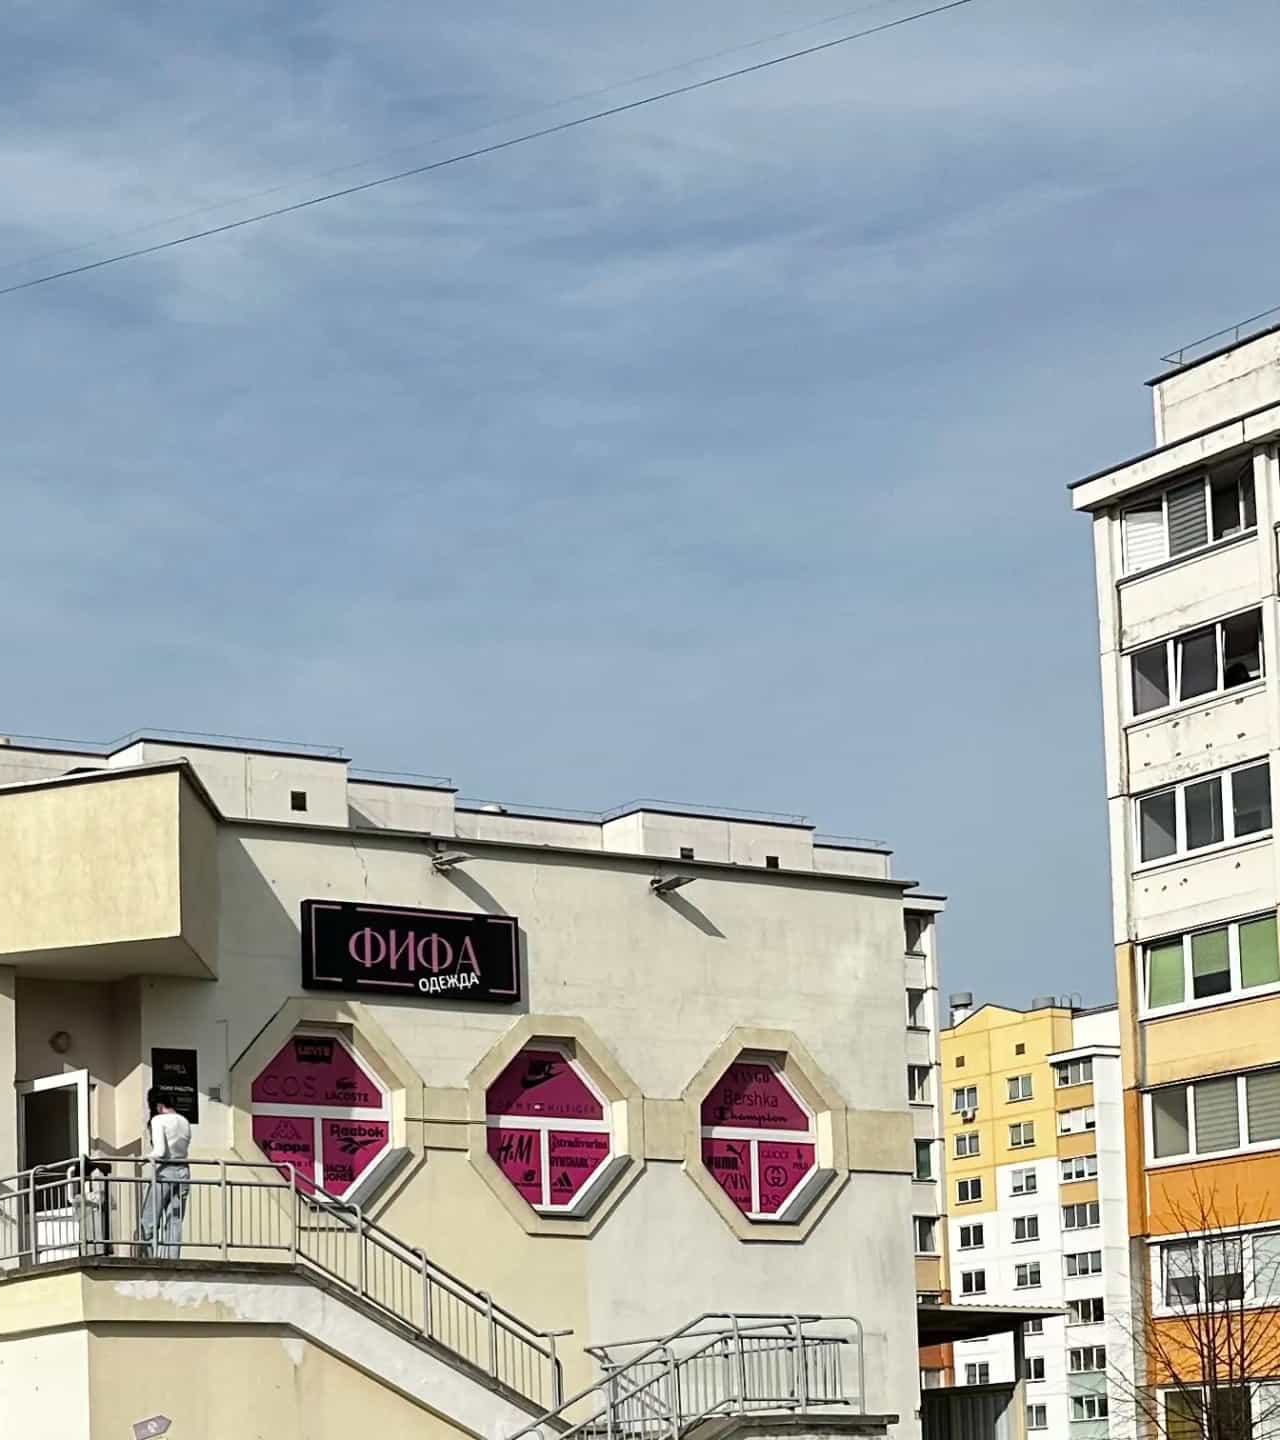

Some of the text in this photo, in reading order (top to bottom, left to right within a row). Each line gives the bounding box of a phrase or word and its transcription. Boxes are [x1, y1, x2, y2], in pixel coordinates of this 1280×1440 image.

[348, 927, 481, 977] ФИФА
[418, 971, 480, 993] ОДЕЖДА
[262, 1075, 319, 1098] COS
[723, 1090, 779, 1108] Bershka
[712, 1106, 788, 1126] Champion
[330, 1124, 385, 1138] Reebok
[261, 1139, 311, 1153] Kappa
